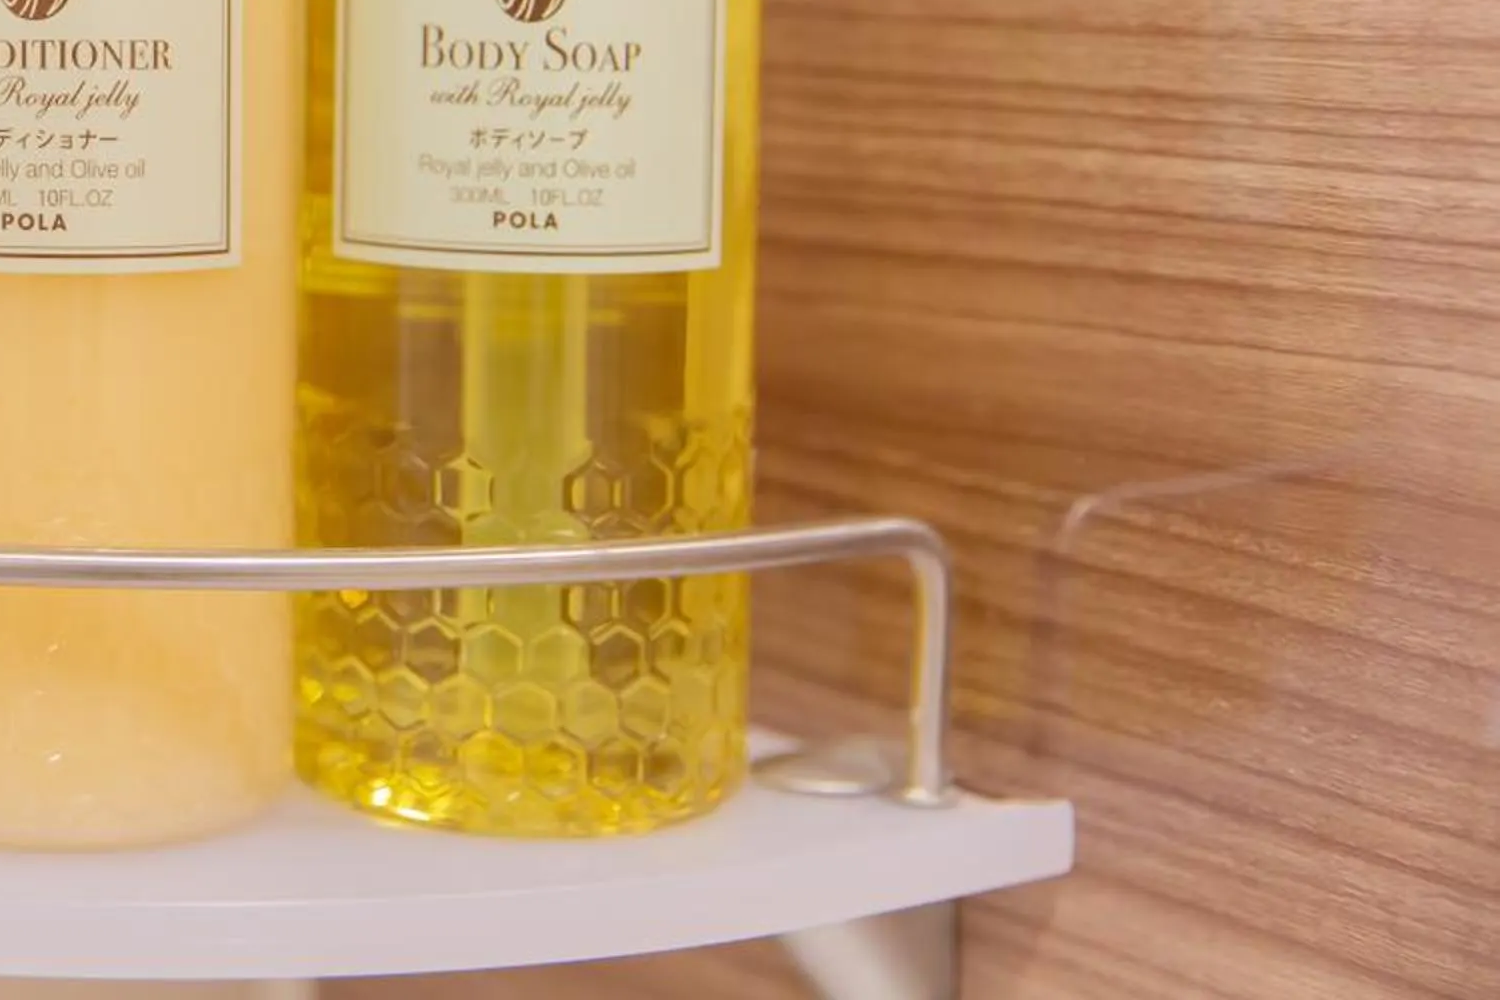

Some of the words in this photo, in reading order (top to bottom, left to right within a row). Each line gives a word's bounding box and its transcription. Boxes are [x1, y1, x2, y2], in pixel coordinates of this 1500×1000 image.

[420, 23, 529, 71] BODY
[543, 25, 642, 73] SOAP
[75, 79, 140, 120] jelly
[430, 79, 480, 107] with
[486, 76, 580, 118] Royal
[570, 81, 631, 120] jelly
[26, 158, 63, 179] and
[70, 158, 119, 180] Olive
[124, 158, 145, 179] oil
[417, 153, 471, 180] Royal
[518, 159, 557, 179] and
[562, 158, 610, 179] Olive
[1, 212, 67, 231] POLA
[493, 210, 558, 230] POLA
